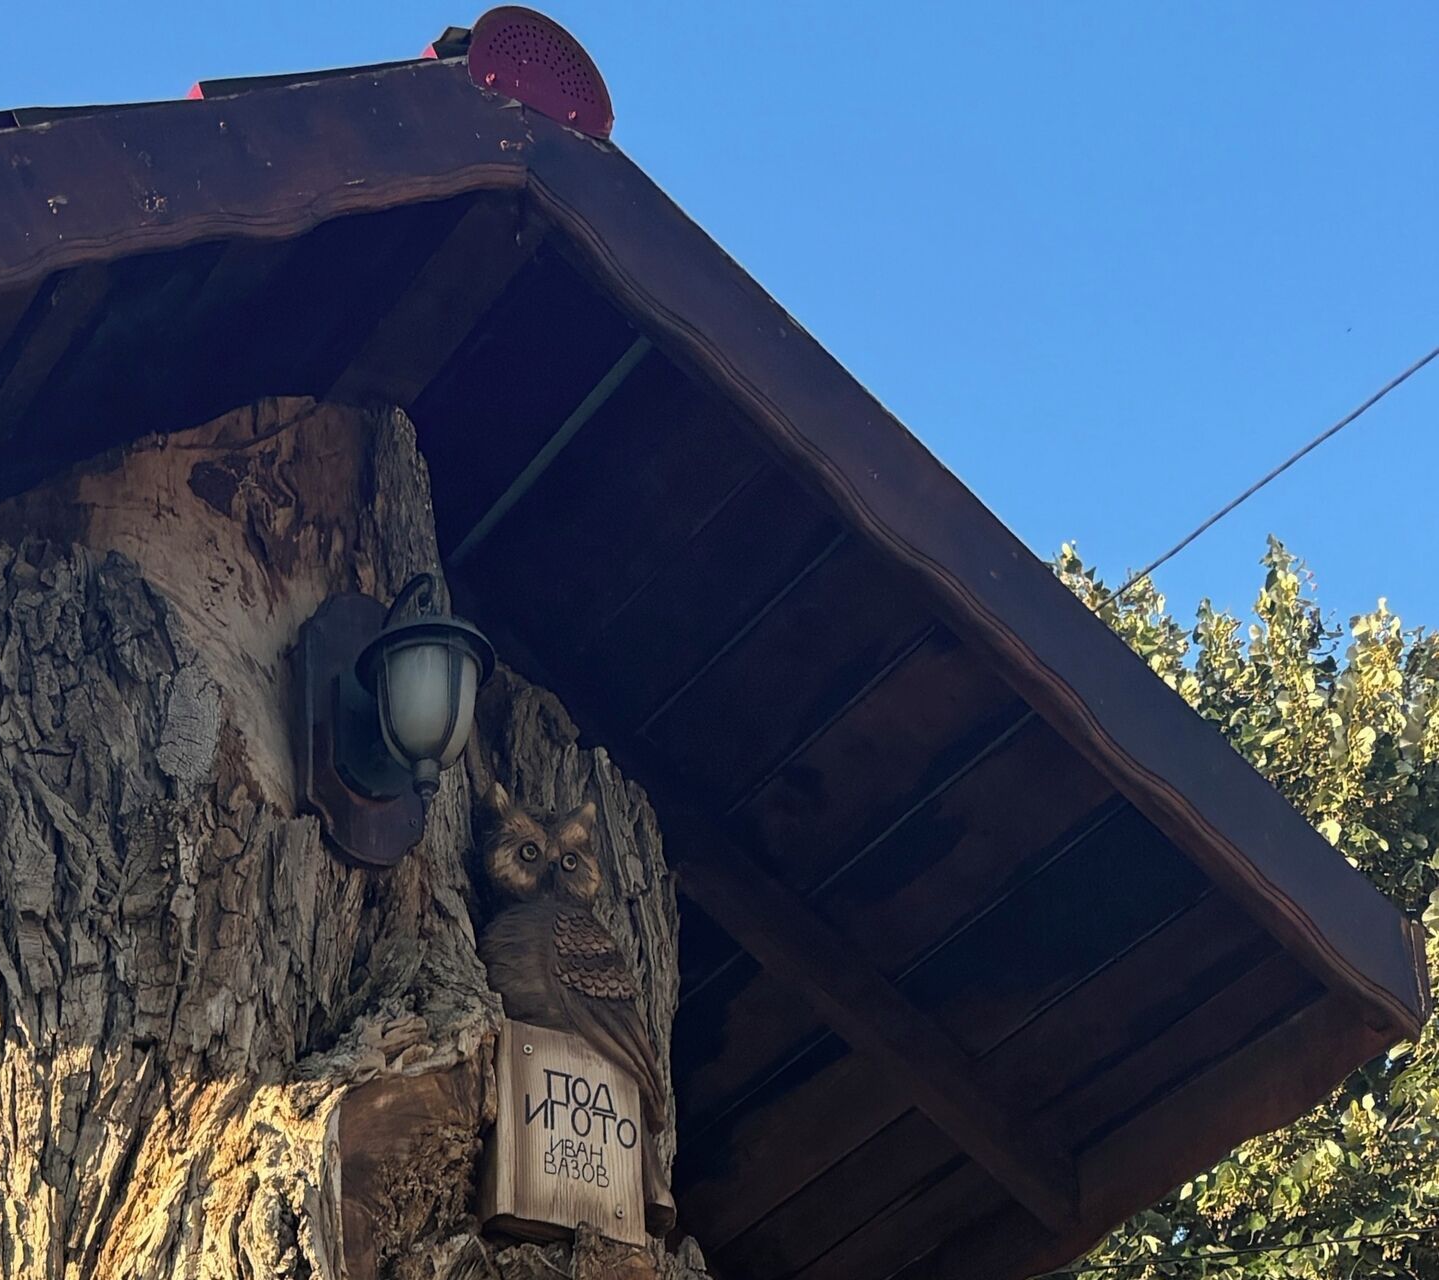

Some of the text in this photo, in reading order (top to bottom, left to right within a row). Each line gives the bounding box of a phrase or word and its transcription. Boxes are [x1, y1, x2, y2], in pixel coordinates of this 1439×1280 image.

[543, 1068, 618, 1115] ПОД
[525, 1093, 638, 1150] ИГОТО
[543, 1151, 610, 1188] ВАЗОВ
[550, 1135, 603, 1166] ИВАН
